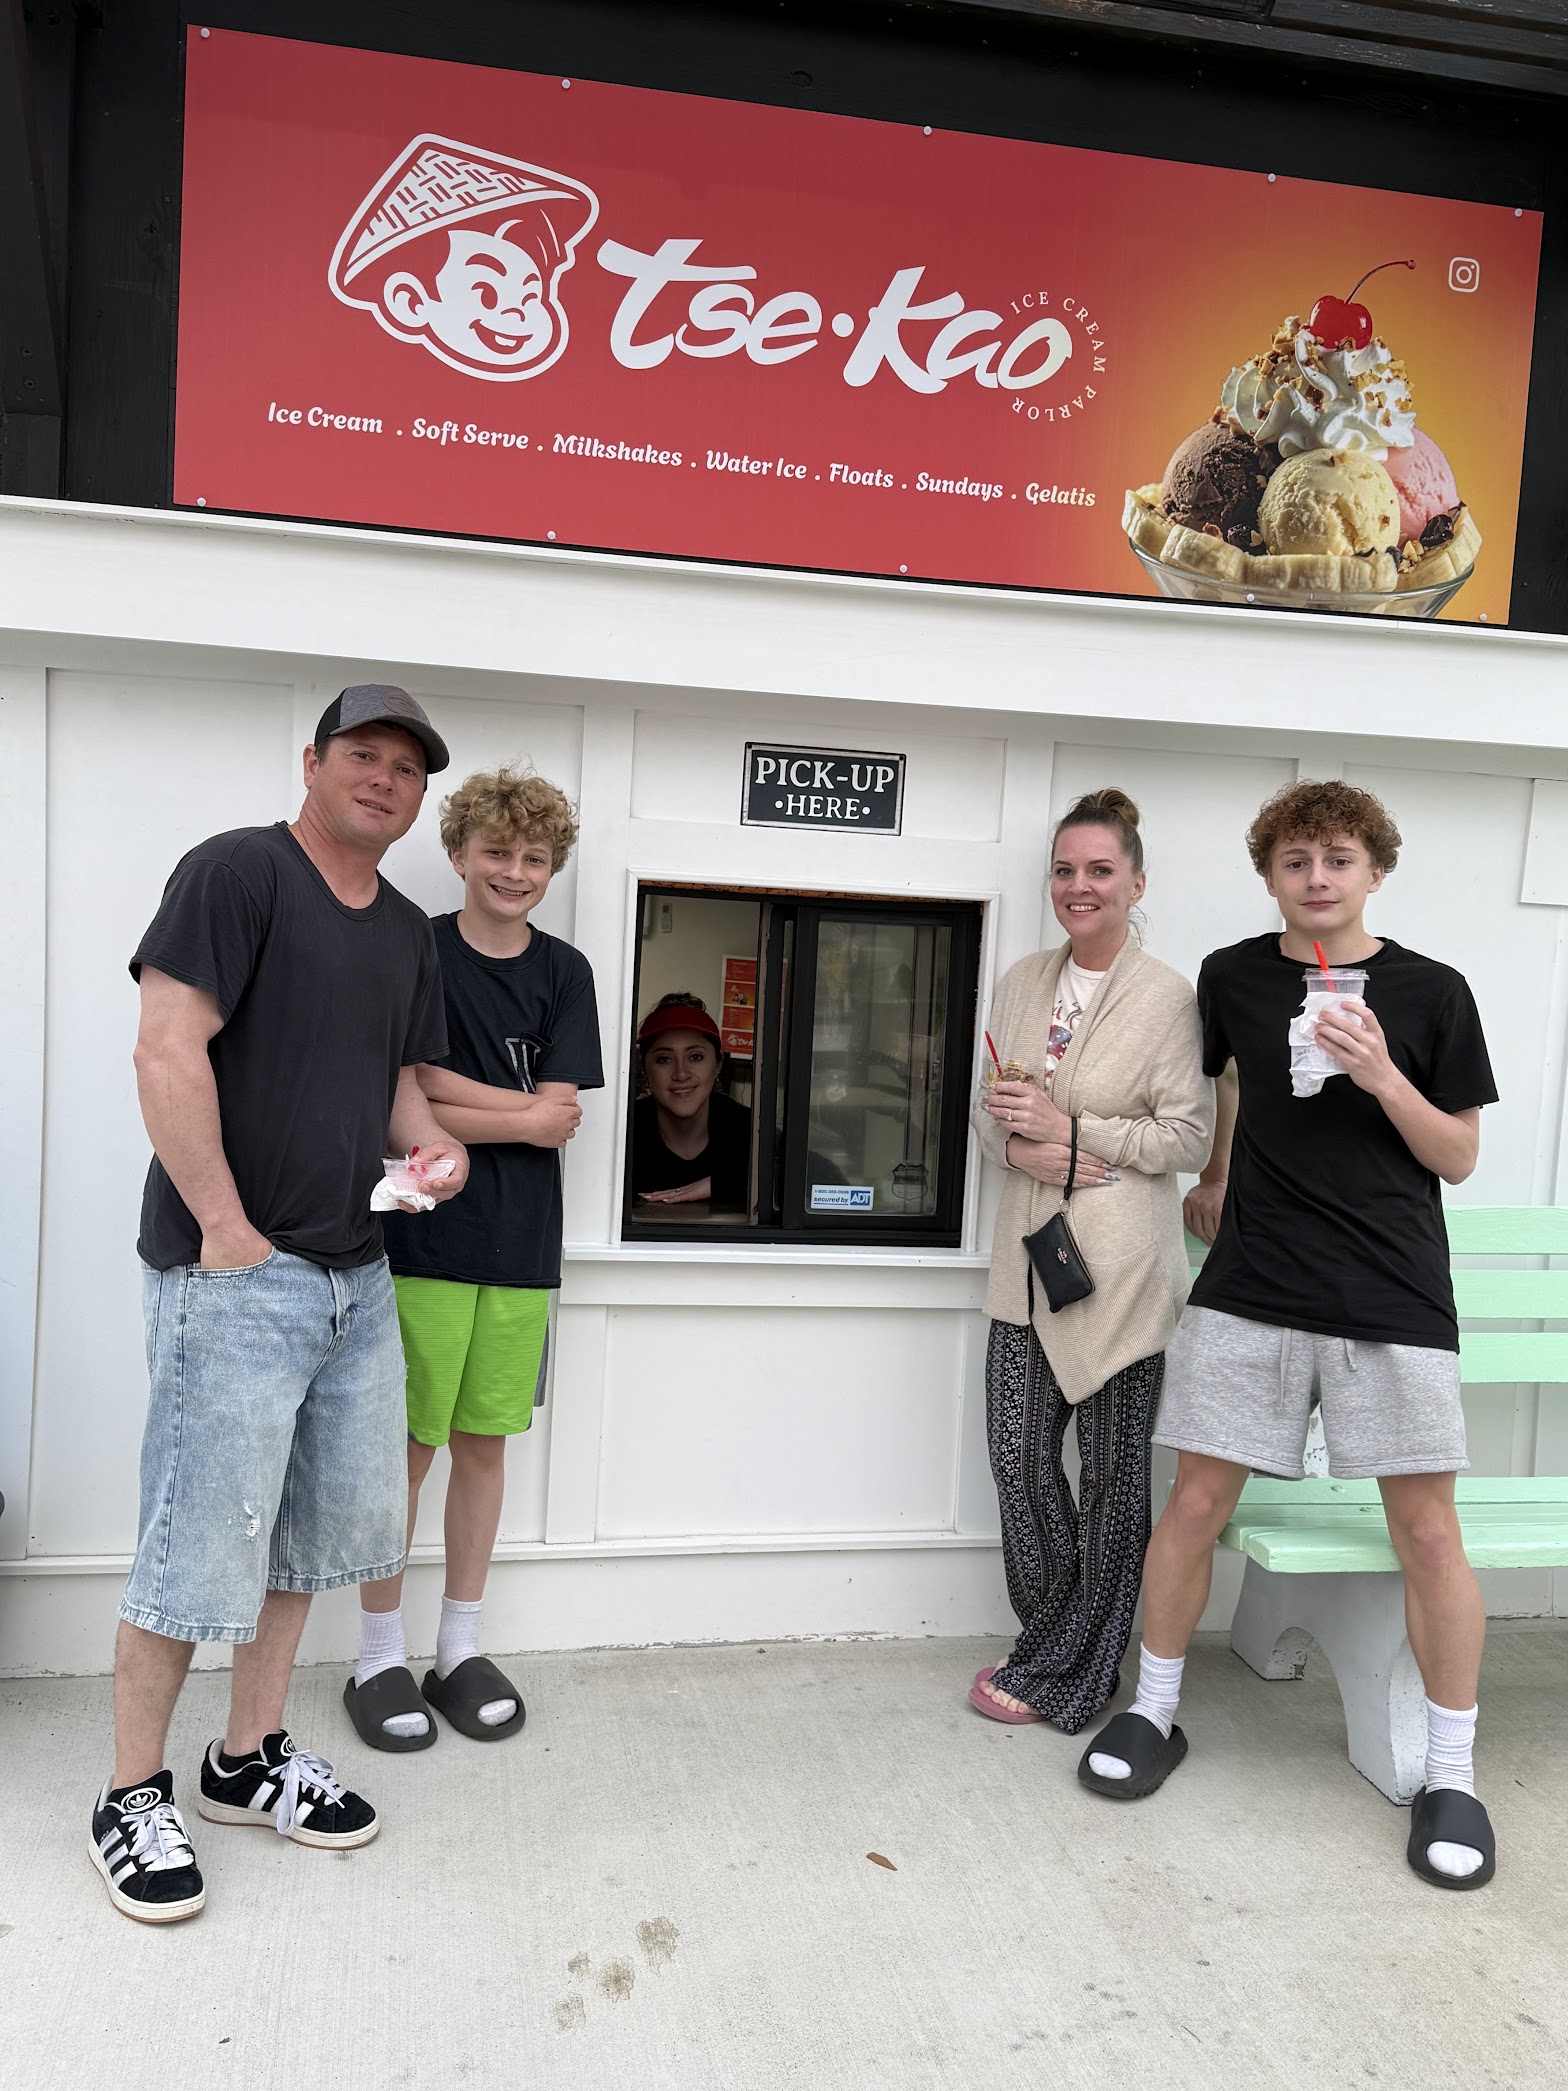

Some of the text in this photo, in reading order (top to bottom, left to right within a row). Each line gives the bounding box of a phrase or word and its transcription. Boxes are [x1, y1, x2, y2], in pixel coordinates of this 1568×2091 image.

[1010, 291, 1107, 422] ICE CREAM PARLOR
[268, 402, 1096, 507] Ice Cream Soft Serve Milkshakes Water Ice Floats Sundays Gelatis
[755, 756, 895, 793] PICK-UP
[850, 1193, 870, 1204] ADT
